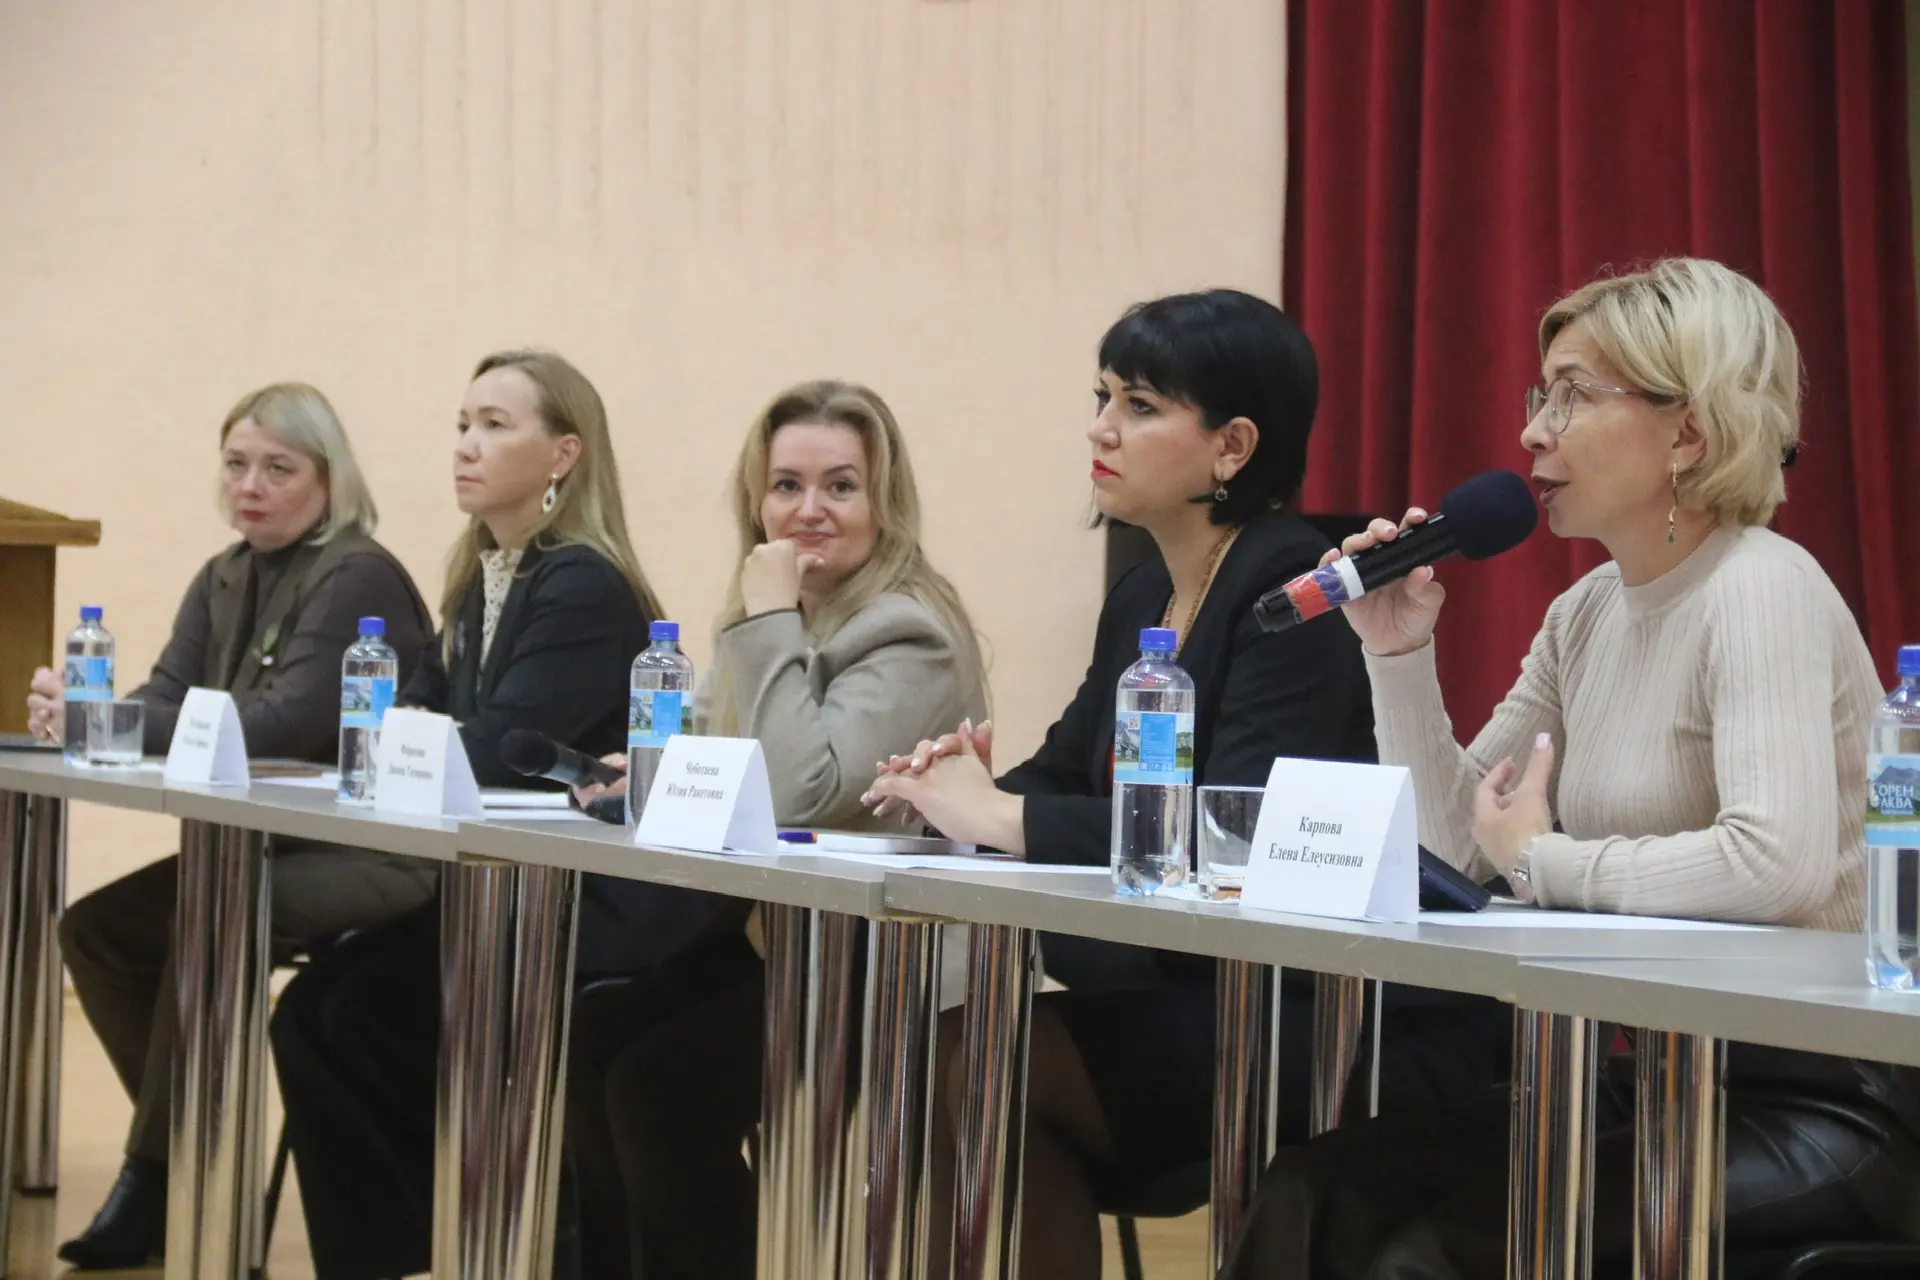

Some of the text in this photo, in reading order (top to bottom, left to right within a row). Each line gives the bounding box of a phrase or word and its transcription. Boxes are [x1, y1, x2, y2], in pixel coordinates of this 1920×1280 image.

[1880, 797, 1913, 809] АКВА
[1298, 816, 1343, 838] Карпова
[1269, 843, 1364, 868] Елена Елеусизовна
